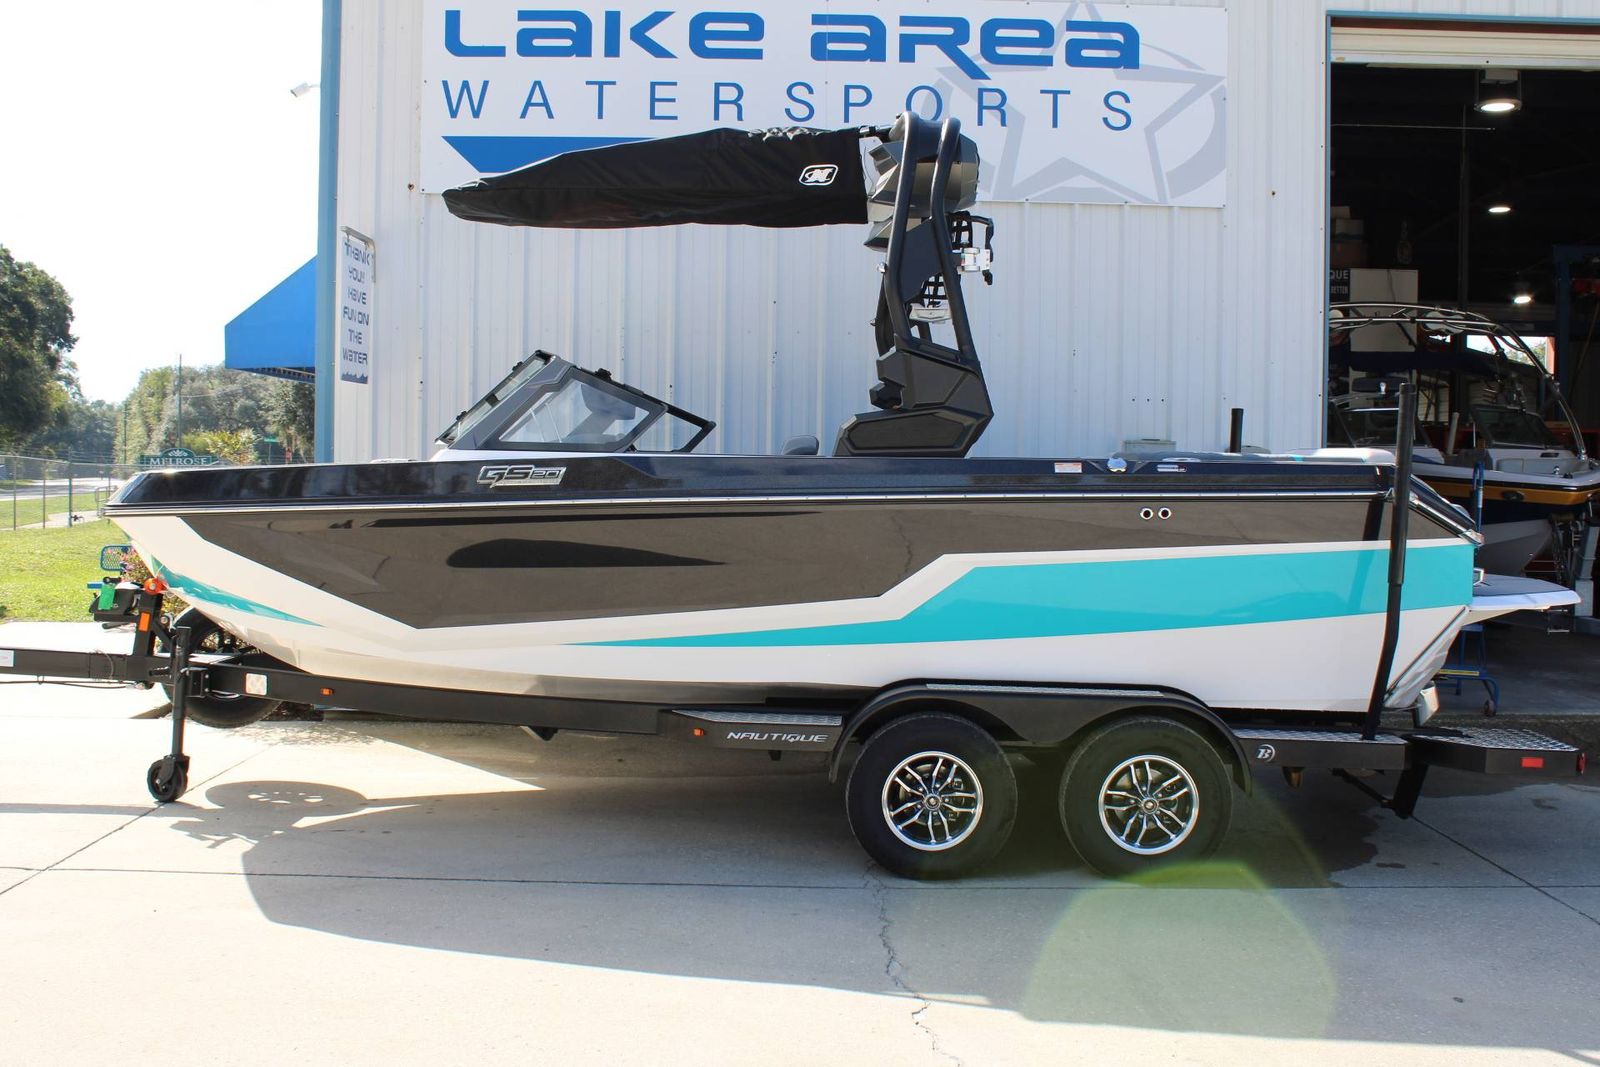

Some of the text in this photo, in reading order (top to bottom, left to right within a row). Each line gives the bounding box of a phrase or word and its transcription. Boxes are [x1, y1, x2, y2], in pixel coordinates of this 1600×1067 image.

[343, 306, 370, 326] FUN ON
[348, 329, 362, 345] THE
[727, 732, 829, 742] NAUTIQUE
